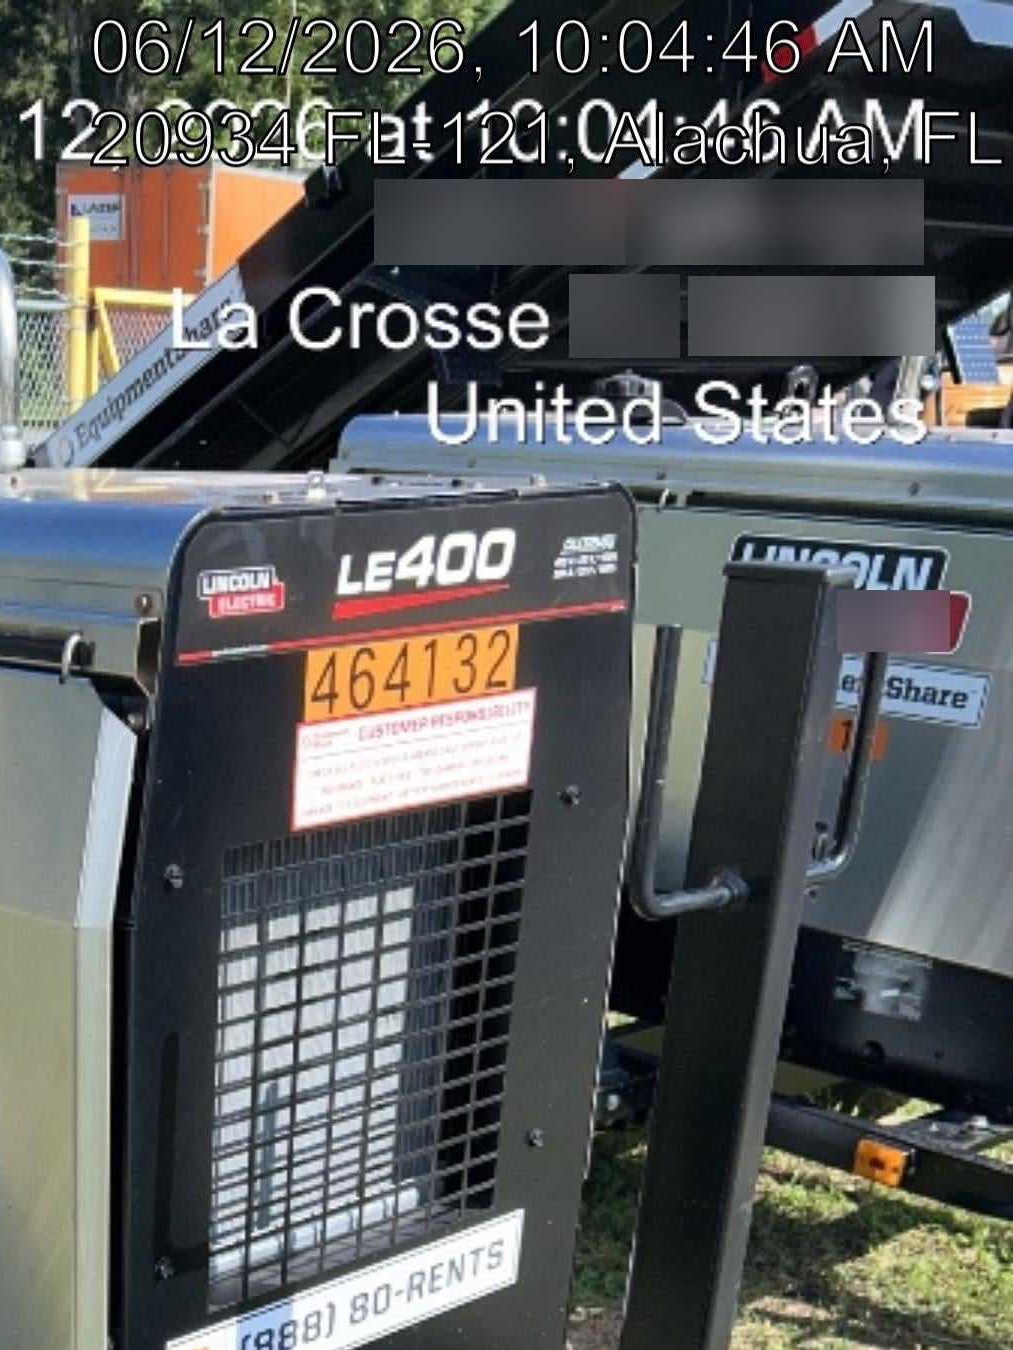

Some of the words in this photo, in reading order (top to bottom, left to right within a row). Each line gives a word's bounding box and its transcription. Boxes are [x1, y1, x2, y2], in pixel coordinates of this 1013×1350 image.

[74, 297, 237, 449] Equipmenthare
[337, 528, 517, 595] LE400
[311, 629, 511, 714] 464132
[349, 1239, 505, 1324] 80-RENTS
